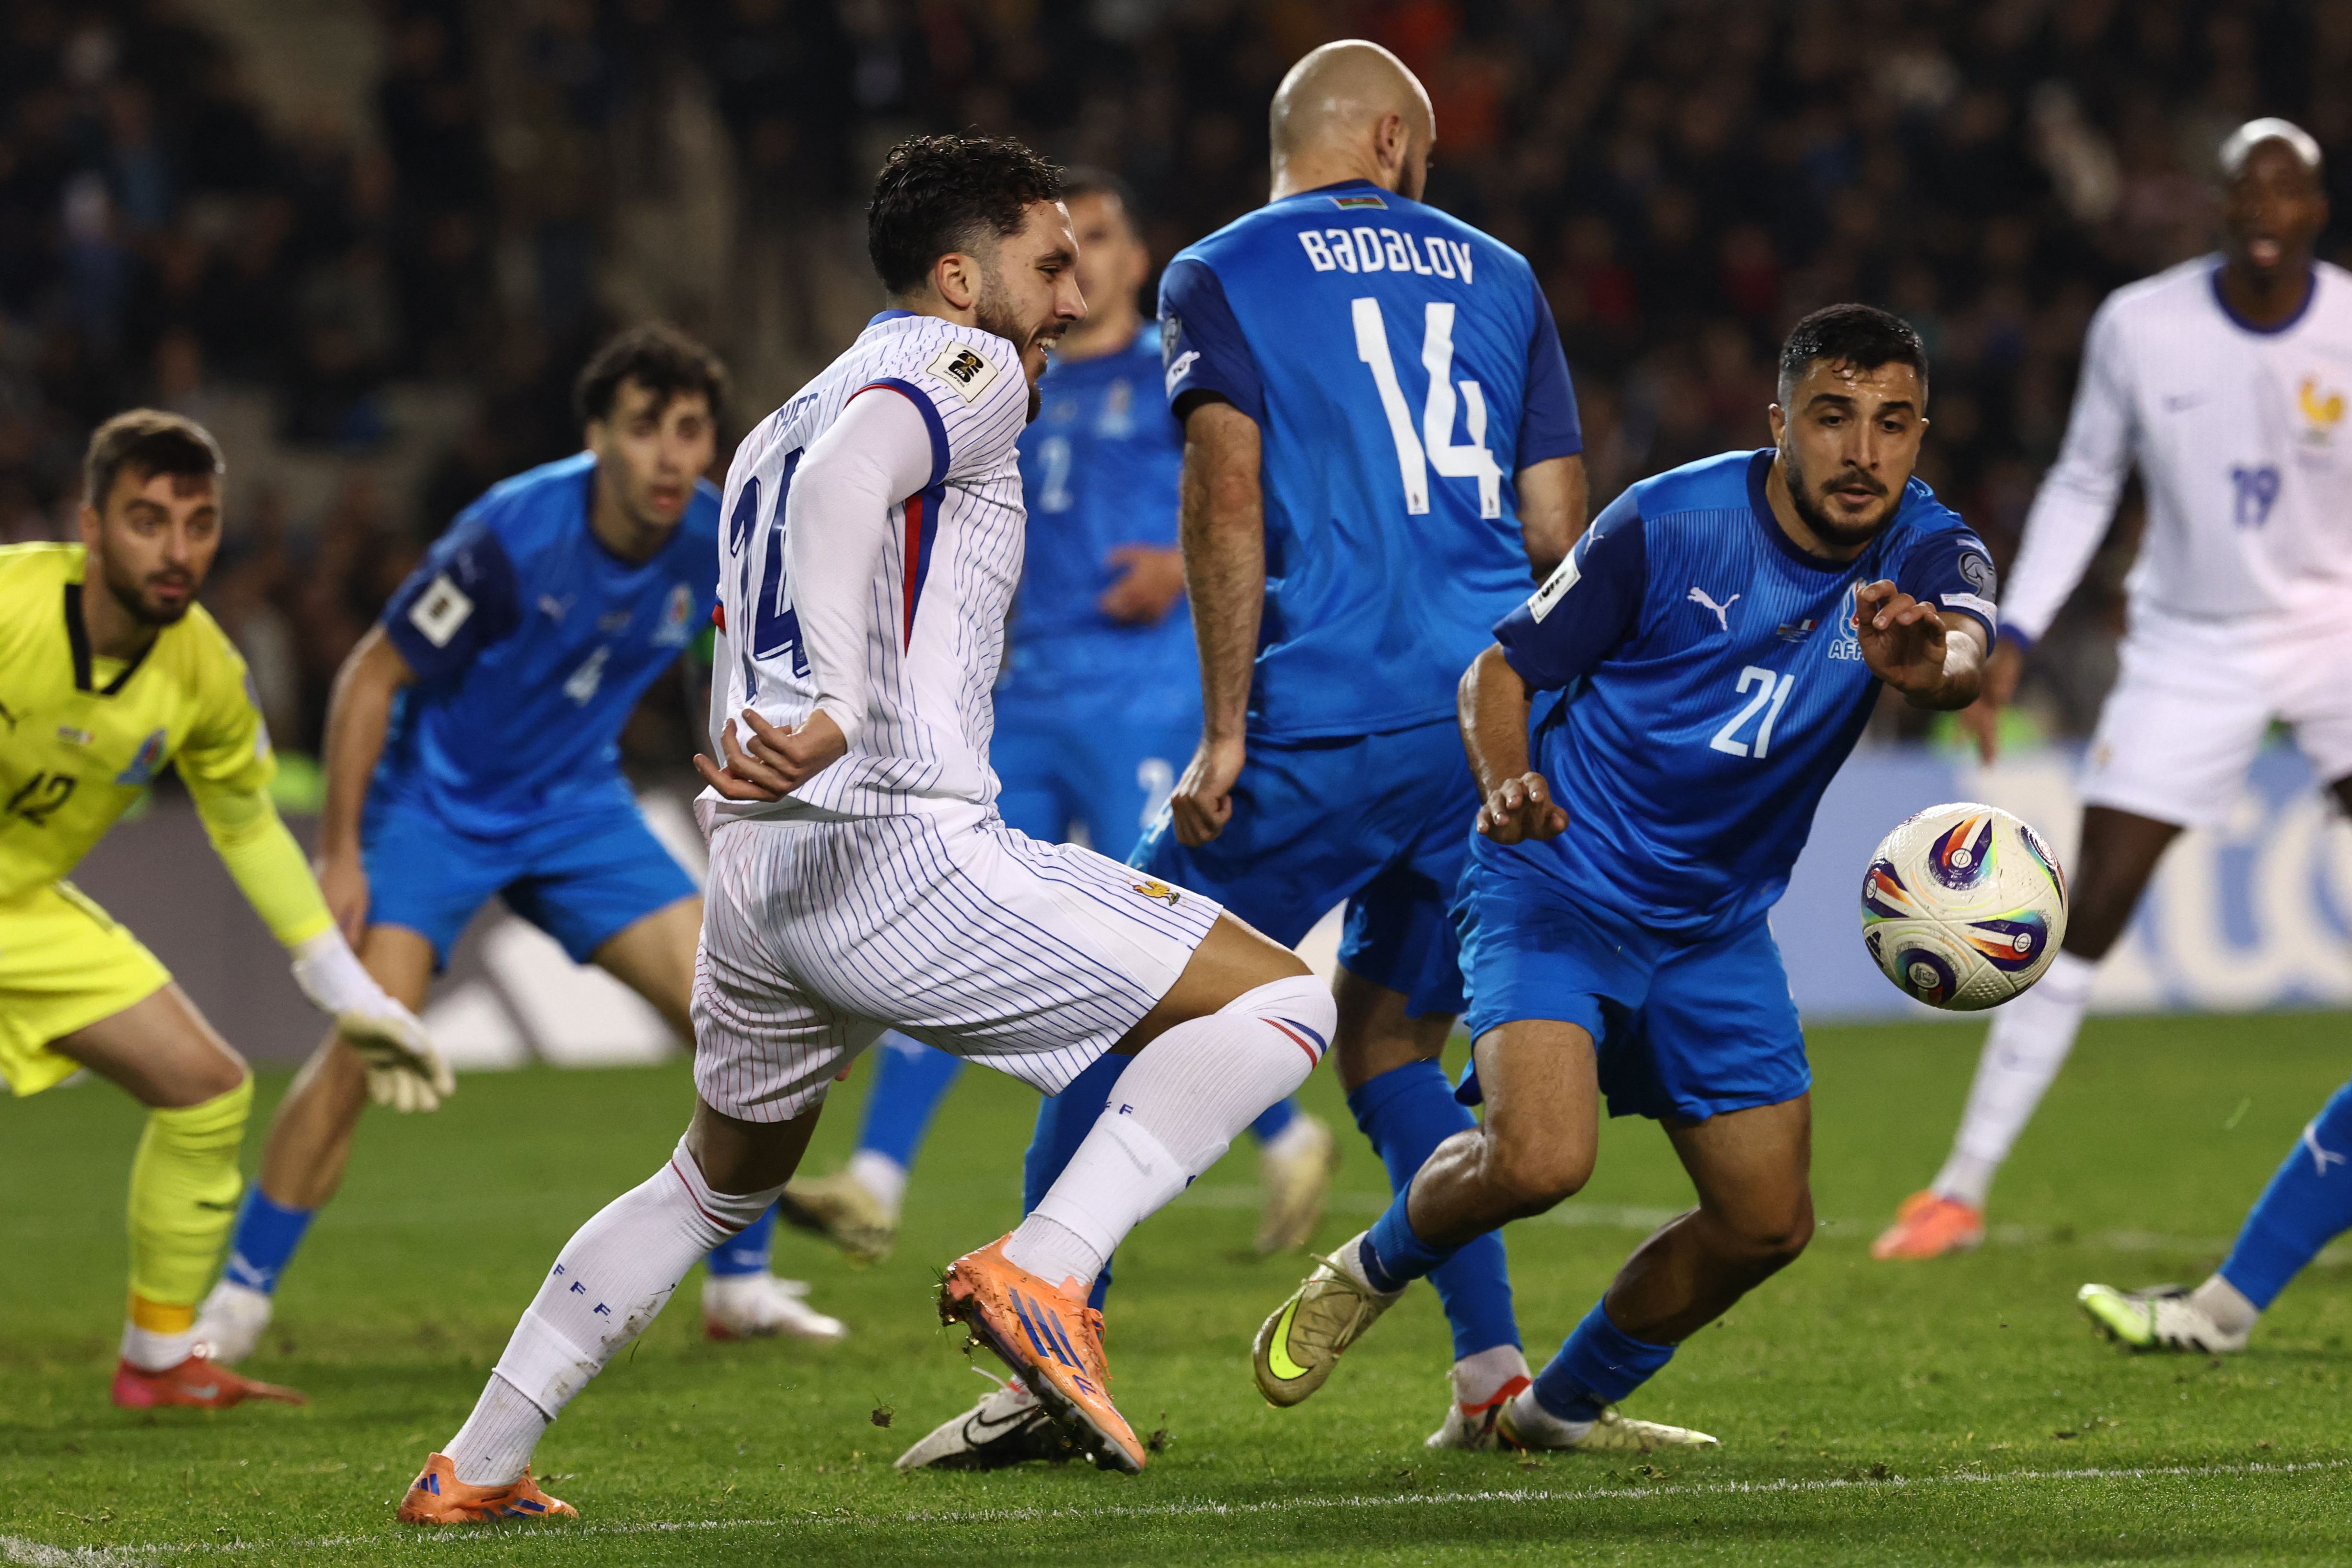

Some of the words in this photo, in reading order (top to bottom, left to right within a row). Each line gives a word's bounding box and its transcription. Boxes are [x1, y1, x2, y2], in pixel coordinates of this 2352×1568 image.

[1351, 296, 1504, 520] 14
[2231, 464, 2281, 528] 19
[730, 446, 812, 706] 24
[1827, 639, 1865, 661] AFF
[1709, 665, 1795, 759] 21
[5, 771, 77, 827] 12
